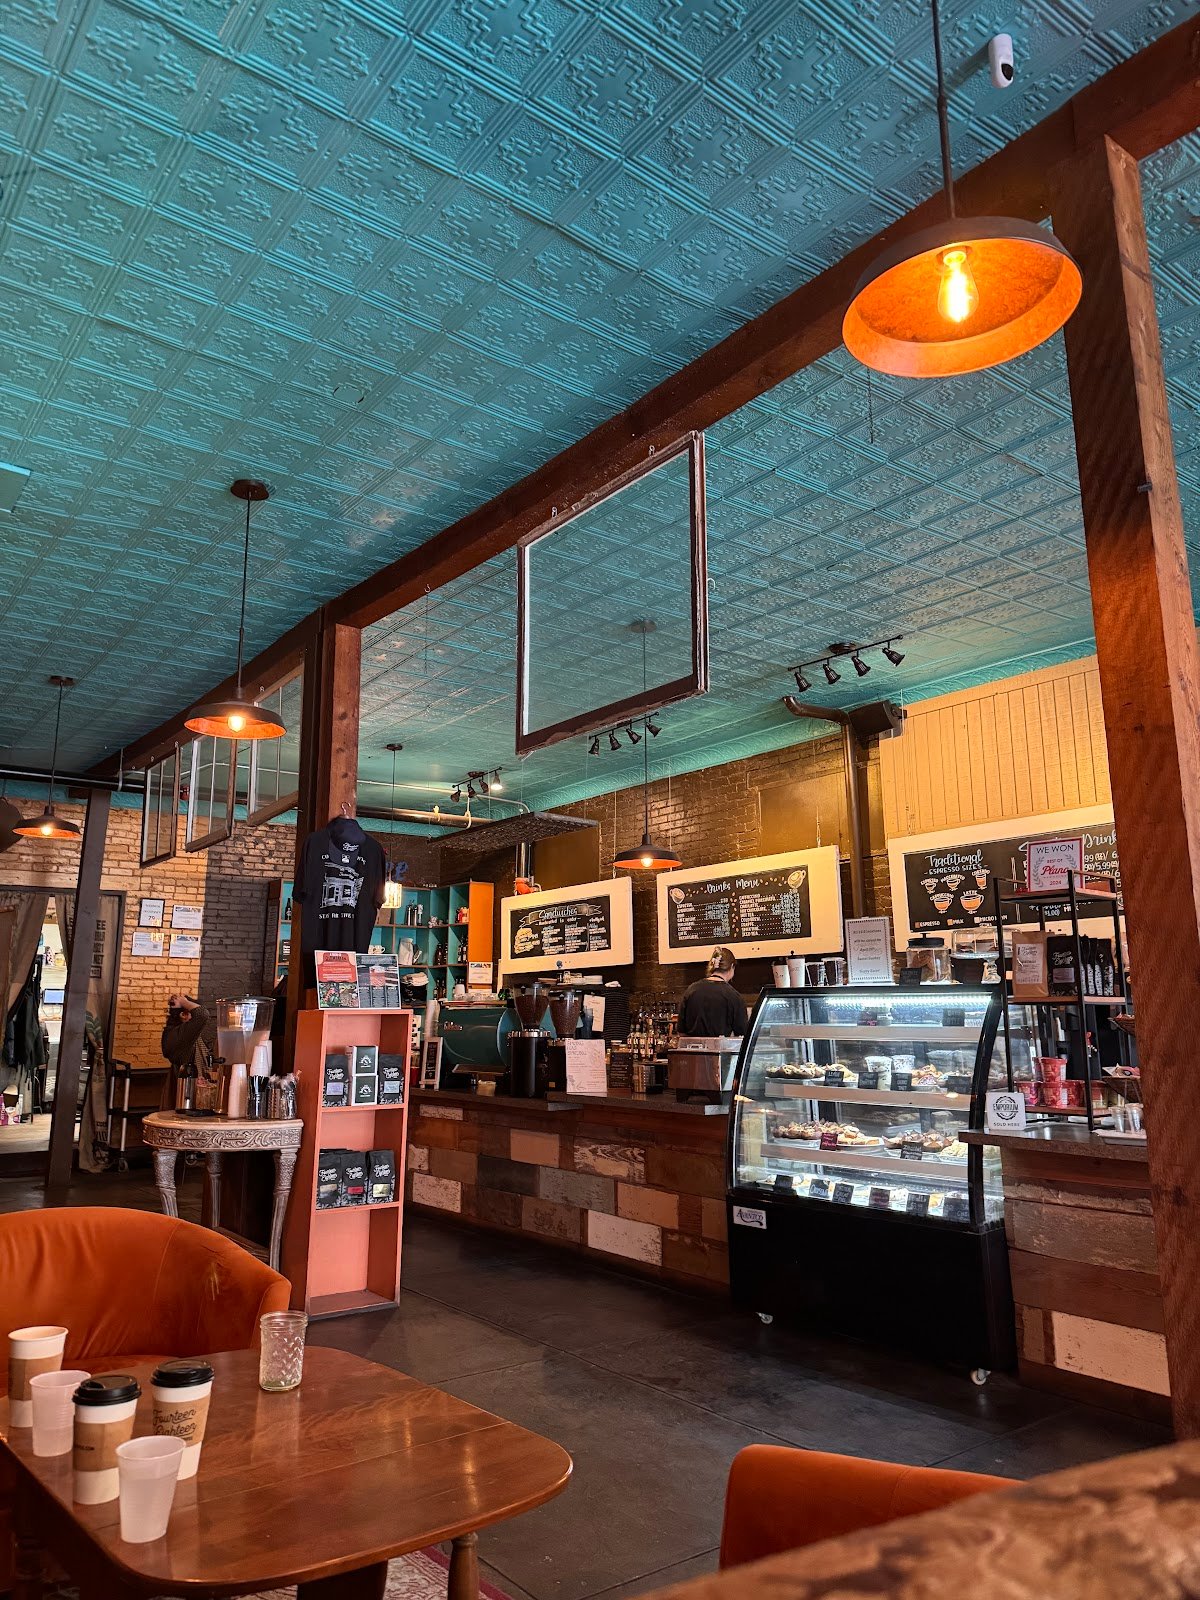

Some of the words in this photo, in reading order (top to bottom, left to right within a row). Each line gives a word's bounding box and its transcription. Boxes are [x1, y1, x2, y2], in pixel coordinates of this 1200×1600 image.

[1051, 844, 1074, 852] WON
[925, 849, 983, 868] Traditional
[928, 866, 960, 875] ESPRESSO
[706, 881, 731, 894] Drinks
[735, 878, 760, 890] Menu
[538, 905, 578, 920] Sandwiches
[993, 1103, 1019, 1111] EMPORIUM
[153, 1408, 197, 1426] Fourteen
